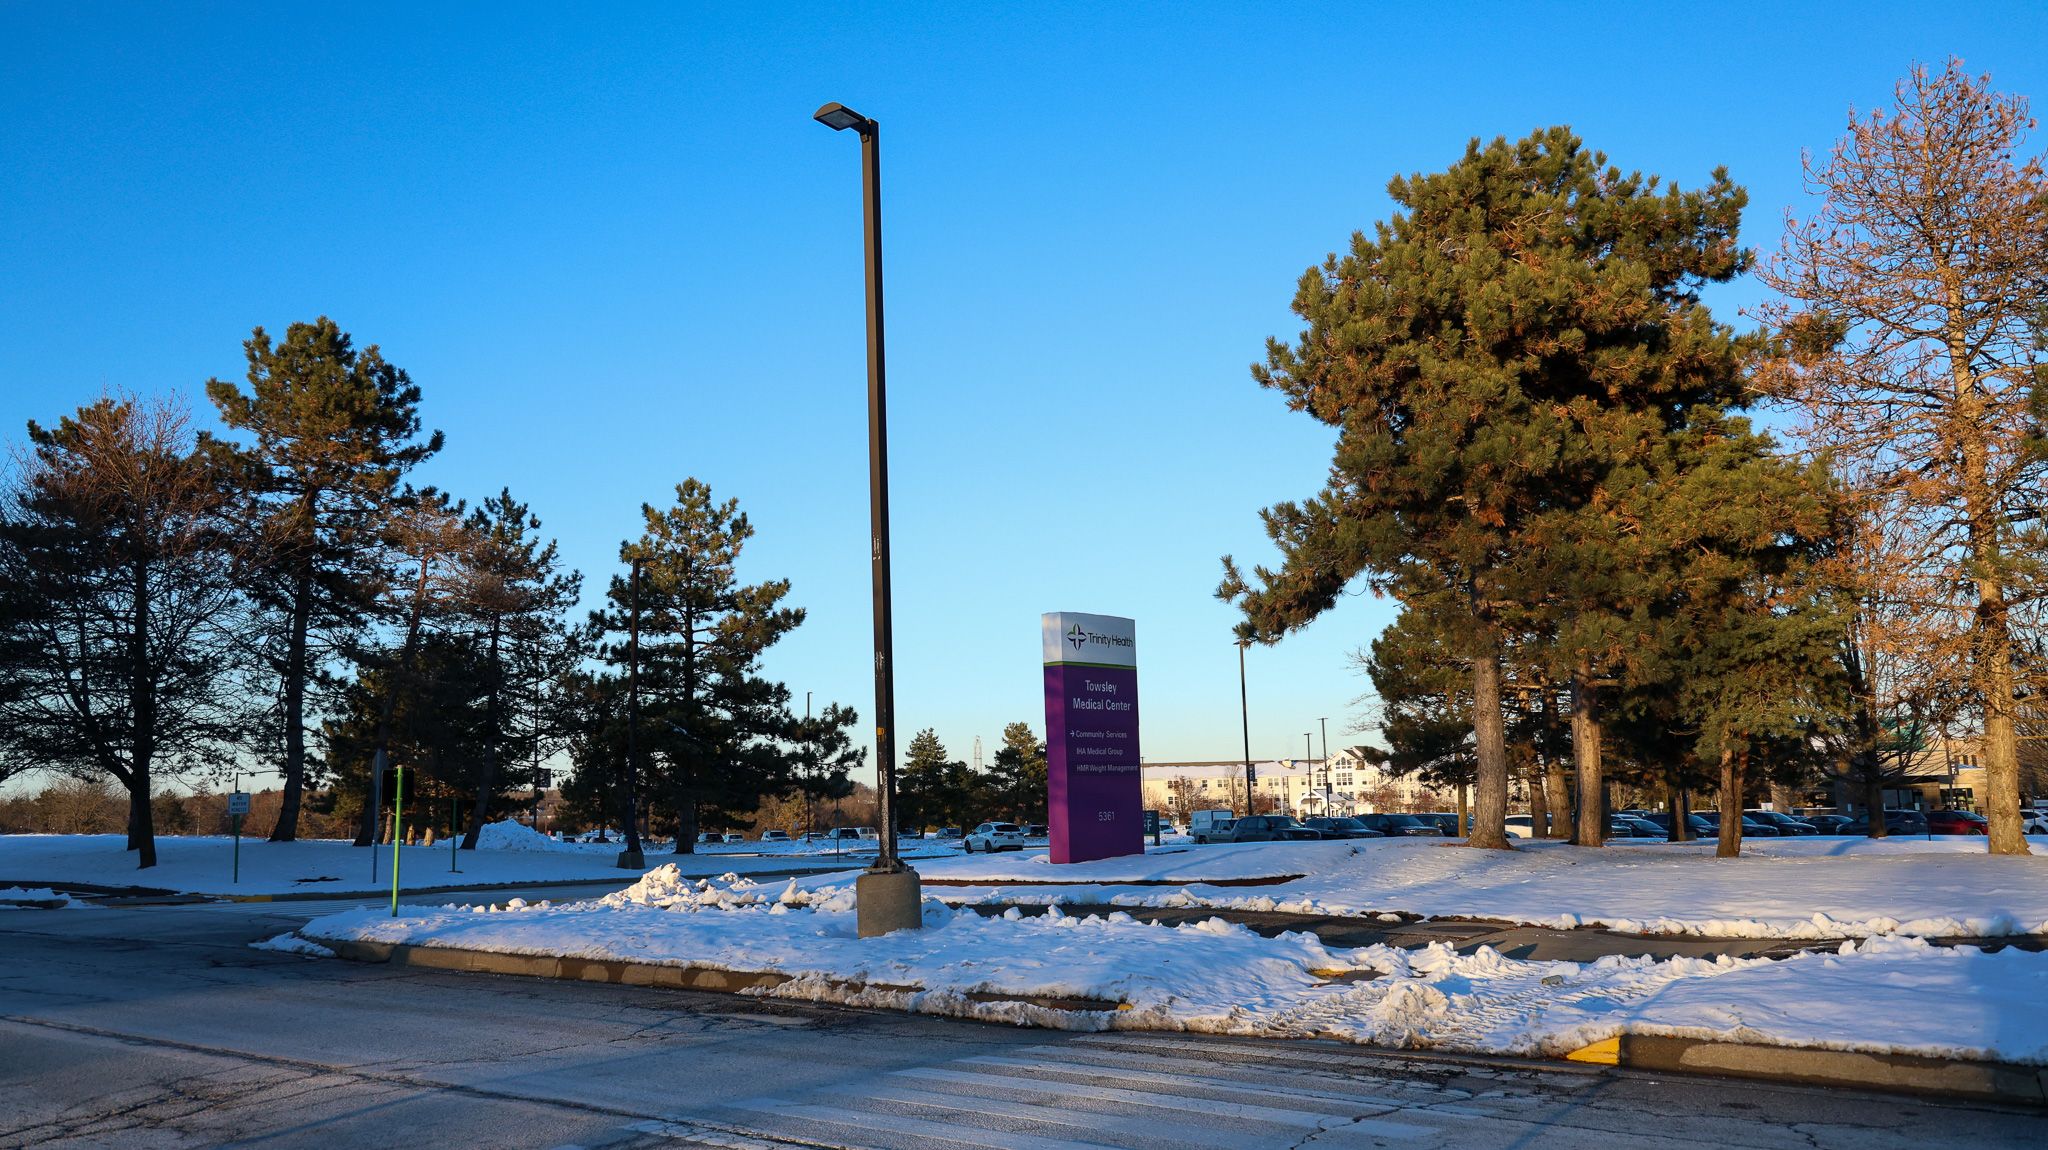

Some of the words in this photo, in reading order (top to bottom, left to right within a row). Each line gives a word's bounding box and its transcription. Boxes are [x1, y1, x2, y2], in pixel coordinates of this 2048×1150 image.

[1087, 632, 1111, 648] Trinity
[1112, 635, 1134, 648] Health
[1085, 680, 1117, 695] Towsley
[1073, 698, 1104, 710] Medical
[1105, 699, 1131, 711] Center
[1075, 730, 1104, 739] Community
[1106, 730, 1128, 738] Services
[1087, 747, 1106, 755] Medical
[1107, 748, 1124, 756] Group
[1090, 764, 1106, 773] Weight
[1107, 764, 1138, 773] Management
[1098, 811, 1115, 821] 5361
